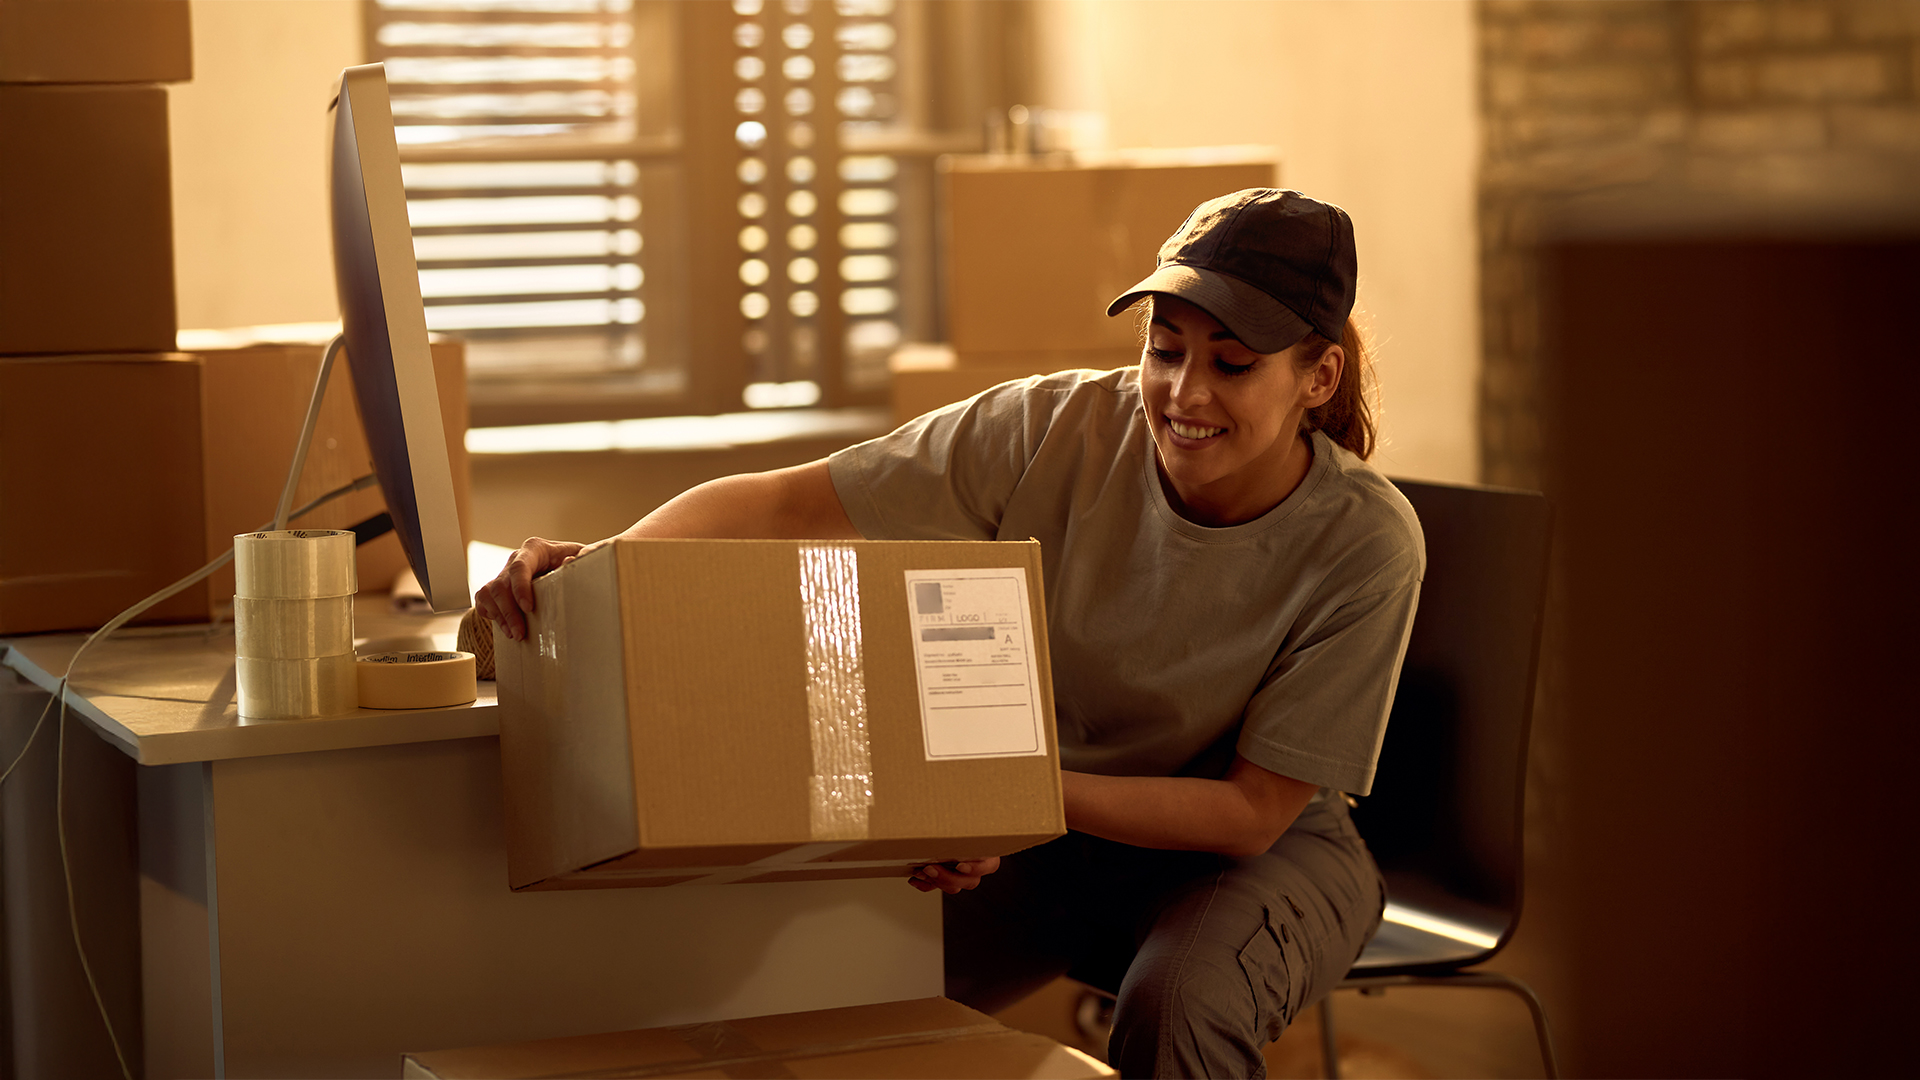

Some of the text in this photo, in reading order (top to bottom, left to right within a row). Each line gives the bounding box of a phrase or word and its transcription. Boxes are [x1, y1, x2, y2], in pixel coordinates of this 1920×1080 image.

[956, 614, 980, 622] LOGO
[1004, 634, 1013, 644] A
[407, 653, 443, 662] Interfilm
